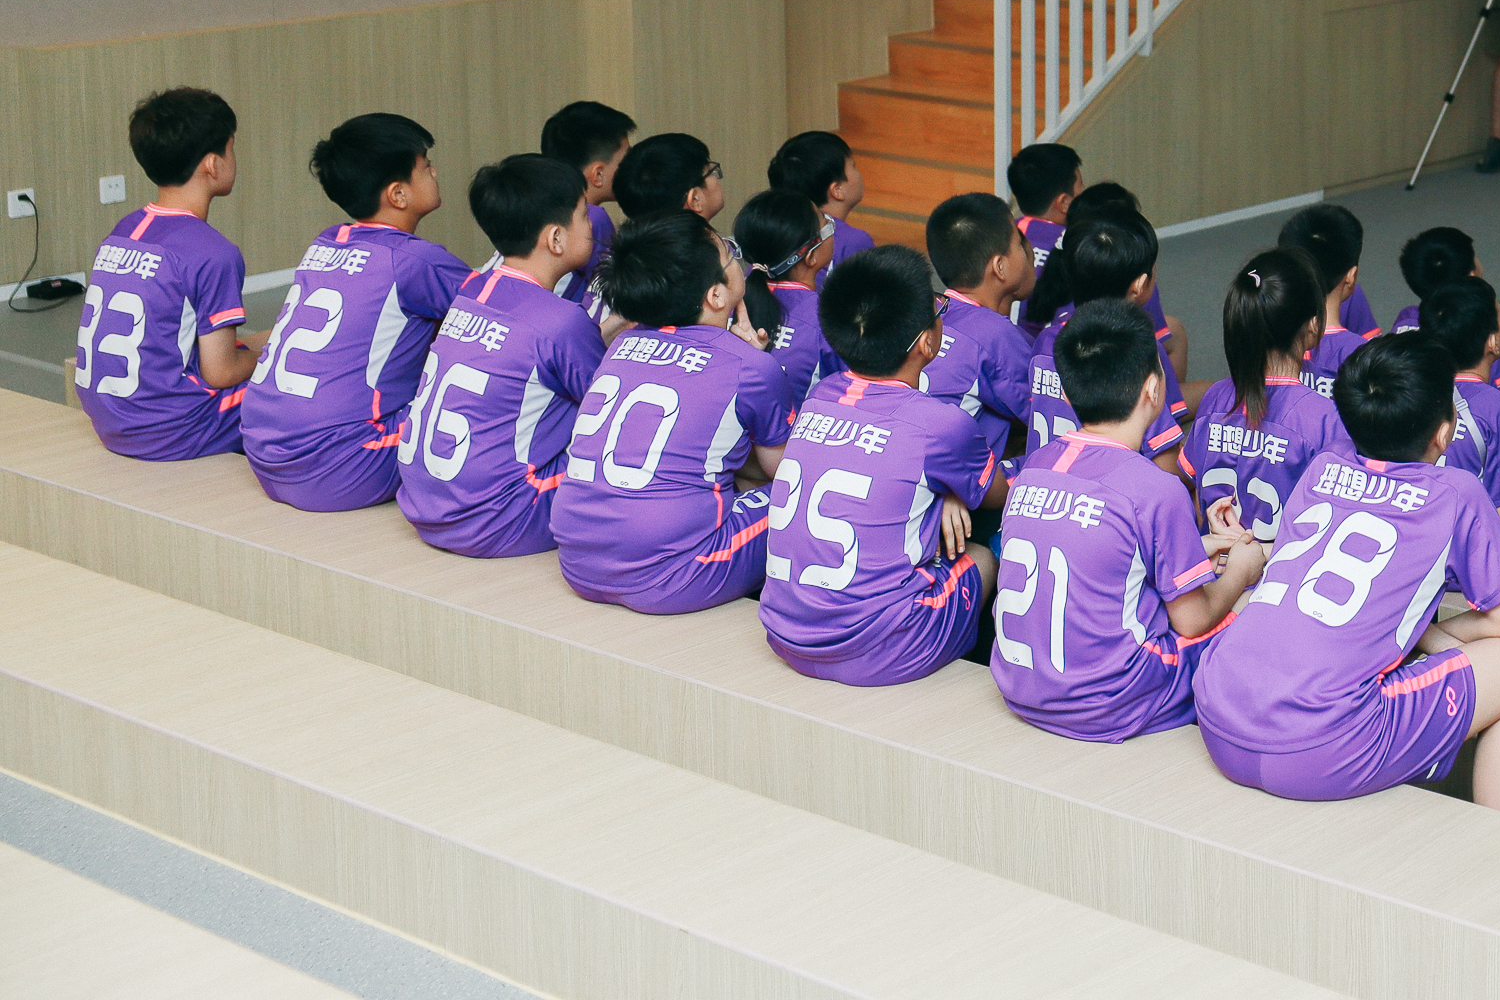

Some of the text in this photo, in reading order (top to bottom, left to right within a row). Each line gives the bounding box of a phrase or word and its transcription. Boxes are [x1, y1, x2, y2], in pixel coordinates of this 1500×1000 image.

[93, 244, 162, 280] 理想少年
[296, 245, 371, 275] 理想少年
[438, 307, 510, 352] 理想少年
[610, 336, 713, 373] 理想少年
[566, 374, 680, 489] 20
[790, 412, 892, 455] 理想少年
[1207, 422, 1289, 464] 理想少年
[1006, 485, 1105, 528] 理想少年
[1312, 462, 1429, 512] 理想少年
[766, 458, 873, 591] 25
[1249, 501, 1398, 627] 28
[995, 537, 1069, 674] 21
